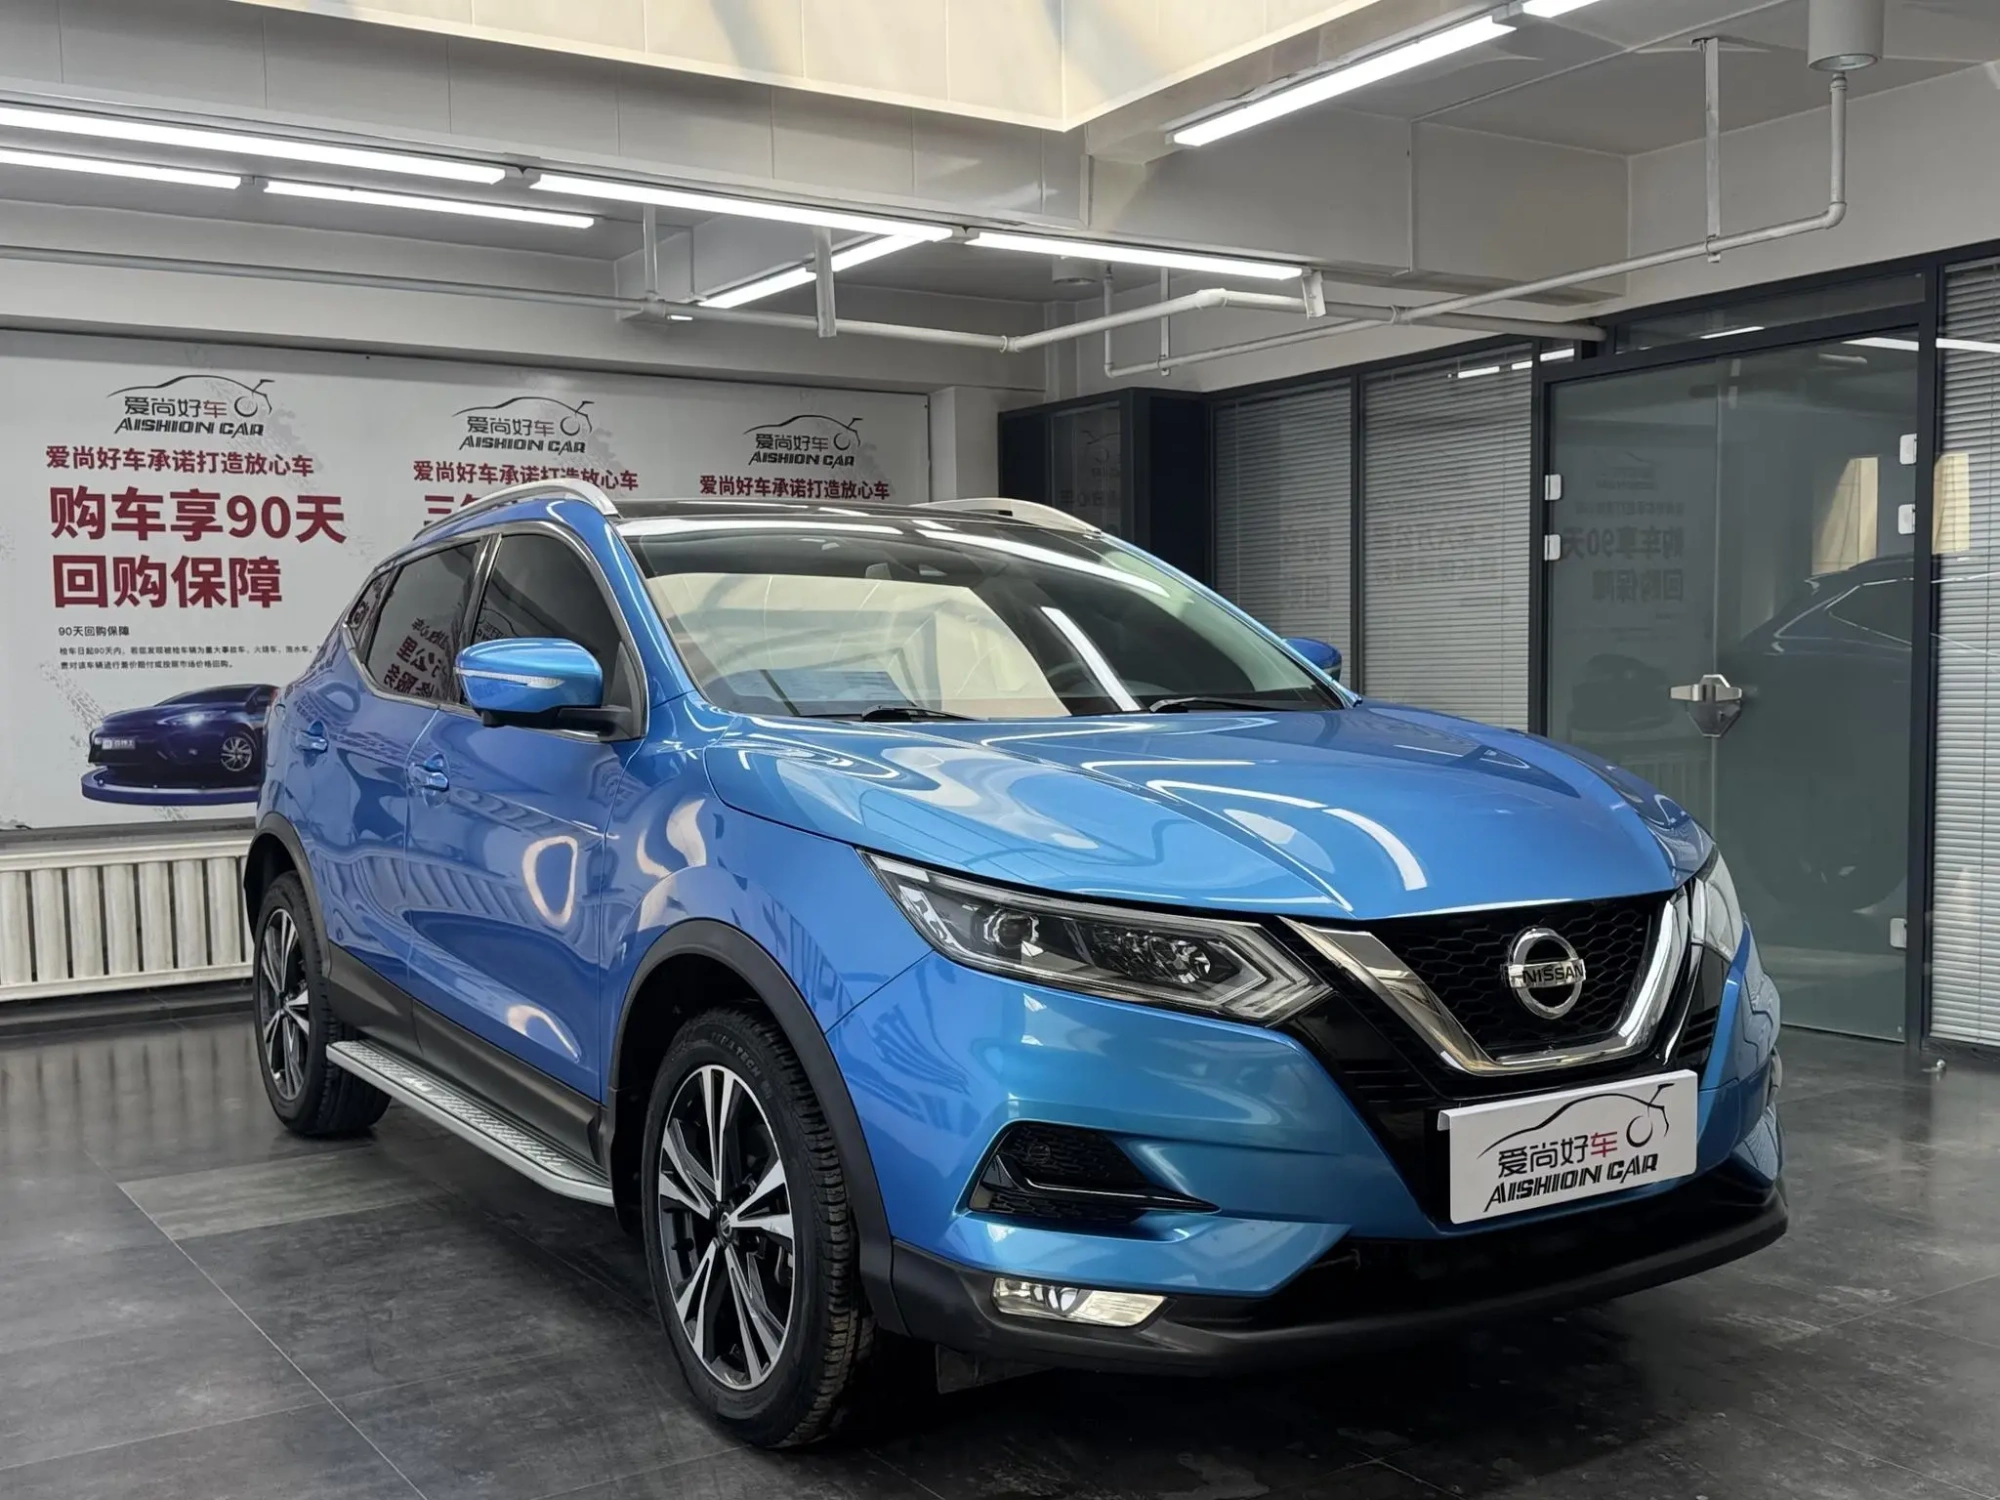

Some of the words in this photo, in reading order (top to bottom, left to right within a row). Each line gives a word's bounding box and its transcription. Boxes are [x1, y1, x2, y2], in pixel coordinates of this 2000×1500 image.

[125, 396, 227, 418] 爱尚好车
[114, 417, 215, 434] AISHION
[219, 422, 264, 438] CAR
[467, 416, 555, 437] 爱尚好车
[459, 435, 544, 451] AISHION
[548, 440, 586, 455] CAR
[756, 433, 829, 452] 爱尚好车
[46, 445, 315, 477] 爱尚好车承诺打造放心车
[748, 451, 820, 466] AISHION
[822, 455, 855, 469] CAR
[700, 474, 890, 500] 爱尚好车承诺打造放心车
[50, 485, 347, 544] 购车享90天
[52, 554, 283, 609] 回购保障
[58, 625, 130, 637] 90天回购保障
[1523, 963, 1585, 984] NISSAN
[1497, 1132, 1618, 1179] 爱尚好车
[1484, 1164, 1603, 1212] AISHION
[1606, 1152, 1659, 1185] CAR
